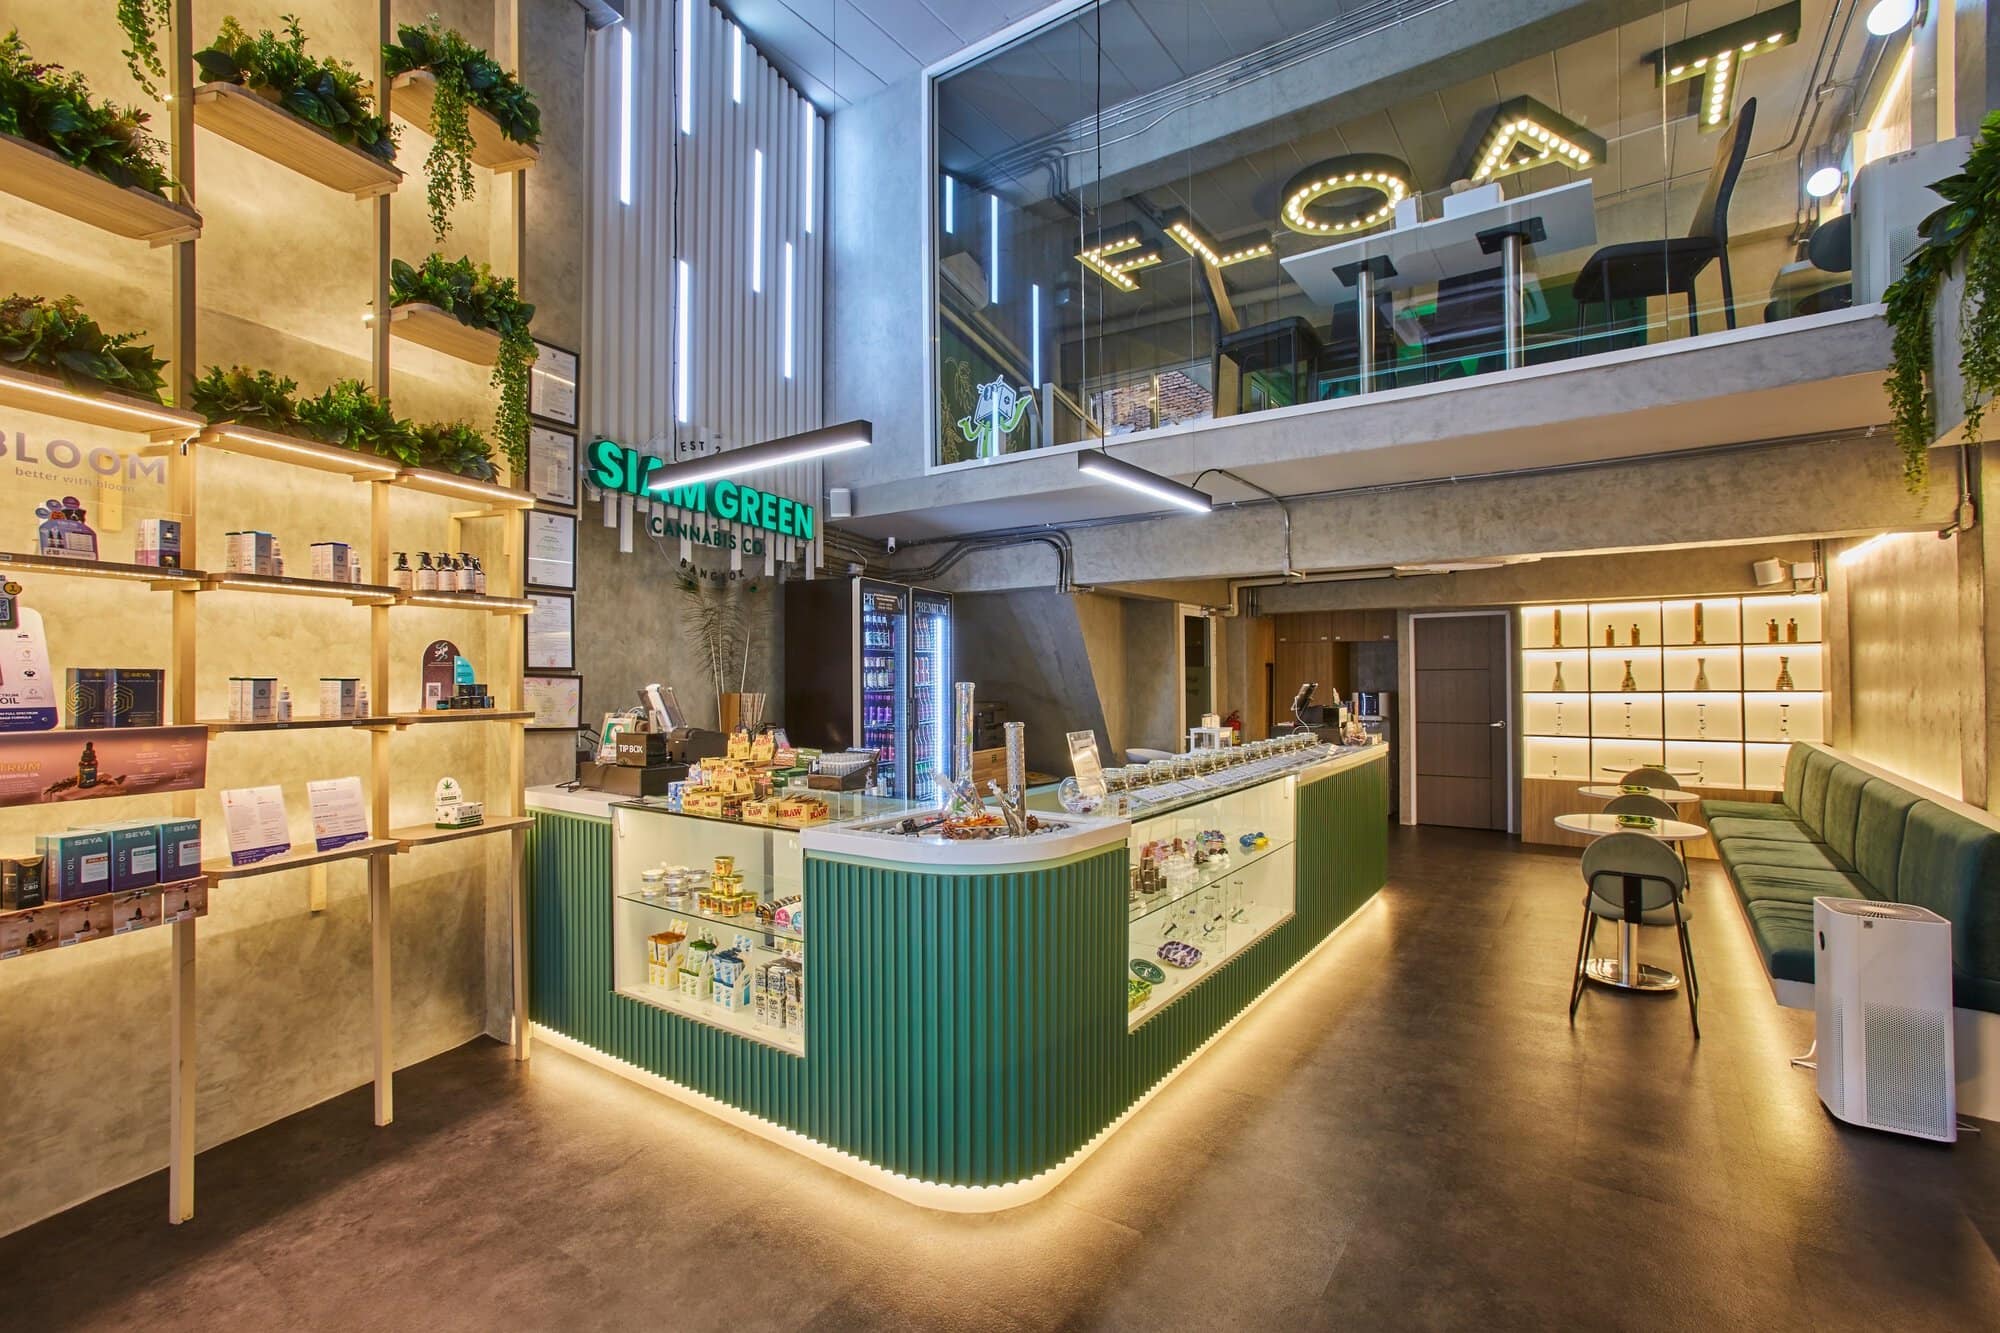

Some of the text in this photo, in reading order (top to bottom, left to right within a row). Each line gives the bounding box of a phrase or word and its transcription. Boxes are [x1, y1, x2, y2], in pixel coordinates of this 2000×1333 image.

[680, 441, 705, 452] EST
[16, 466, 135, 493] better with bloom
[711, 479, 815, 541] GREEN
[651, 517, 737, 550] CANNABIS
[914, 600, 947, 616] PREMIUM
[619, 744, 629, 753] TIP
[629, 745, 643, 753] BOX
[783, 808, 802, 817] RAW
[809, 807, 828, 819] RAW
